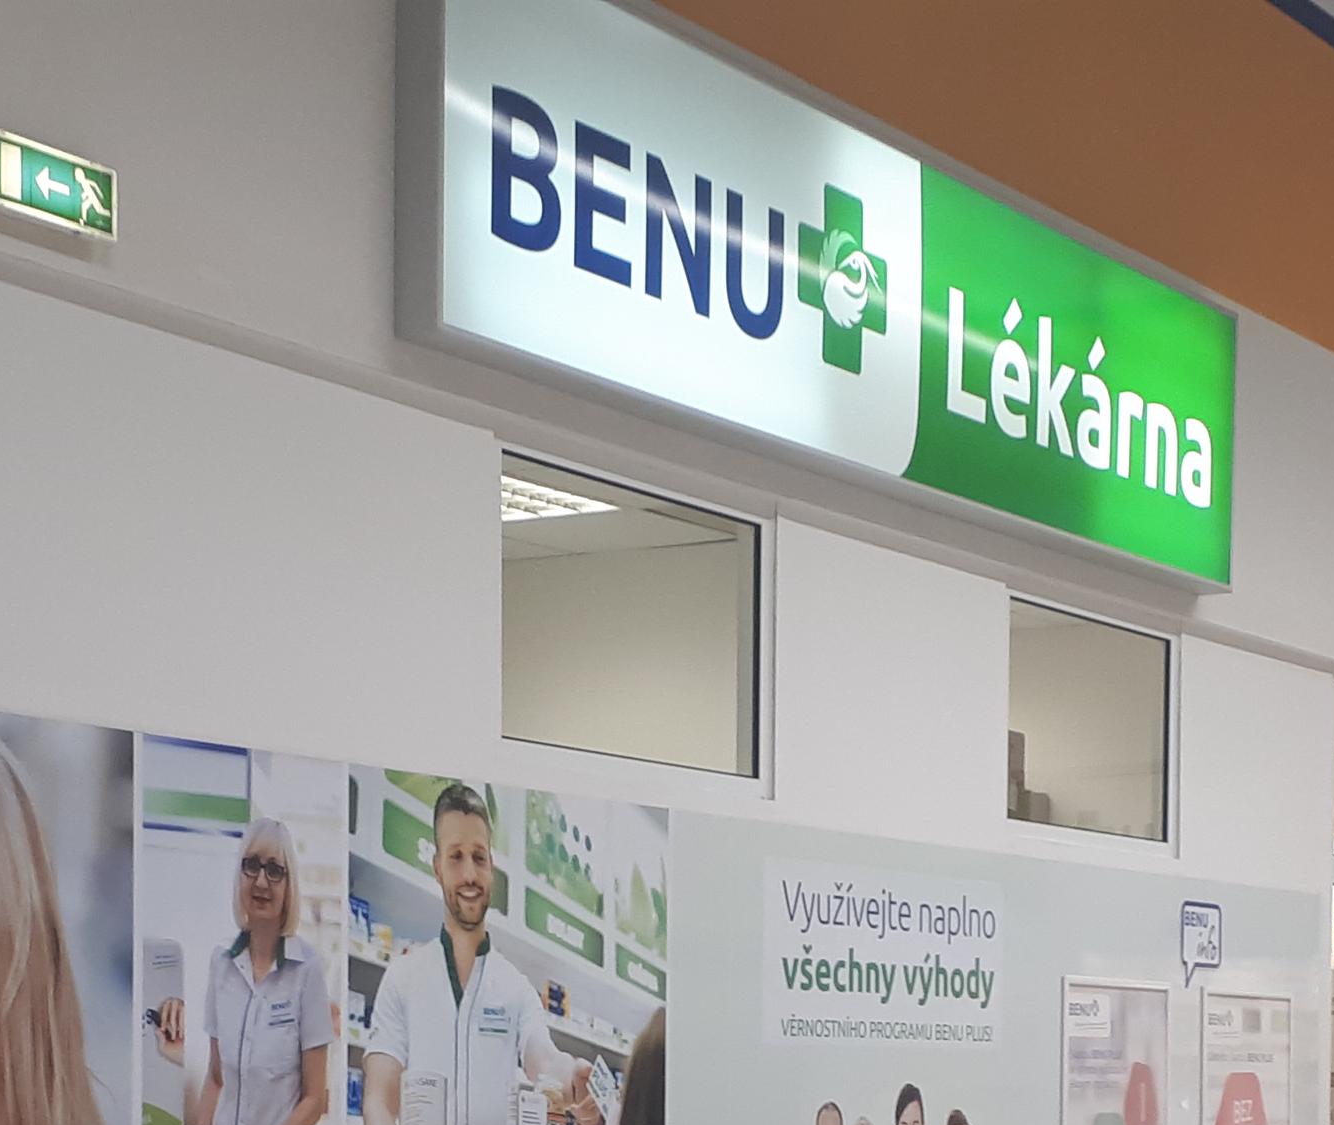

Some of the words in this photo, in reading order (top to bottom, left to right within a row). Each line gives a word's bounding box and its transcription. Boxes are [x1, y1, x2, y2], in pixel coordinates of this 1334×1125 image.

[490, 84, 784, 341] BENU
[946, 285, 1213, 509] Lékárna
[781, 879, 912, 940] Využívejte
[919, 895, 996, 945] naplno
[781, 943, 897, 1005] všechny
[903, 952, 995, 1010] výhody
[780, 1013, 868, 1039] VĚRNOSTNÍHO
[869, 1020, 934, 1041] PROGRAMU
[935, 1023, 965, 1041] BENU
[1233, 1098, 1254, 1124] BEZ
